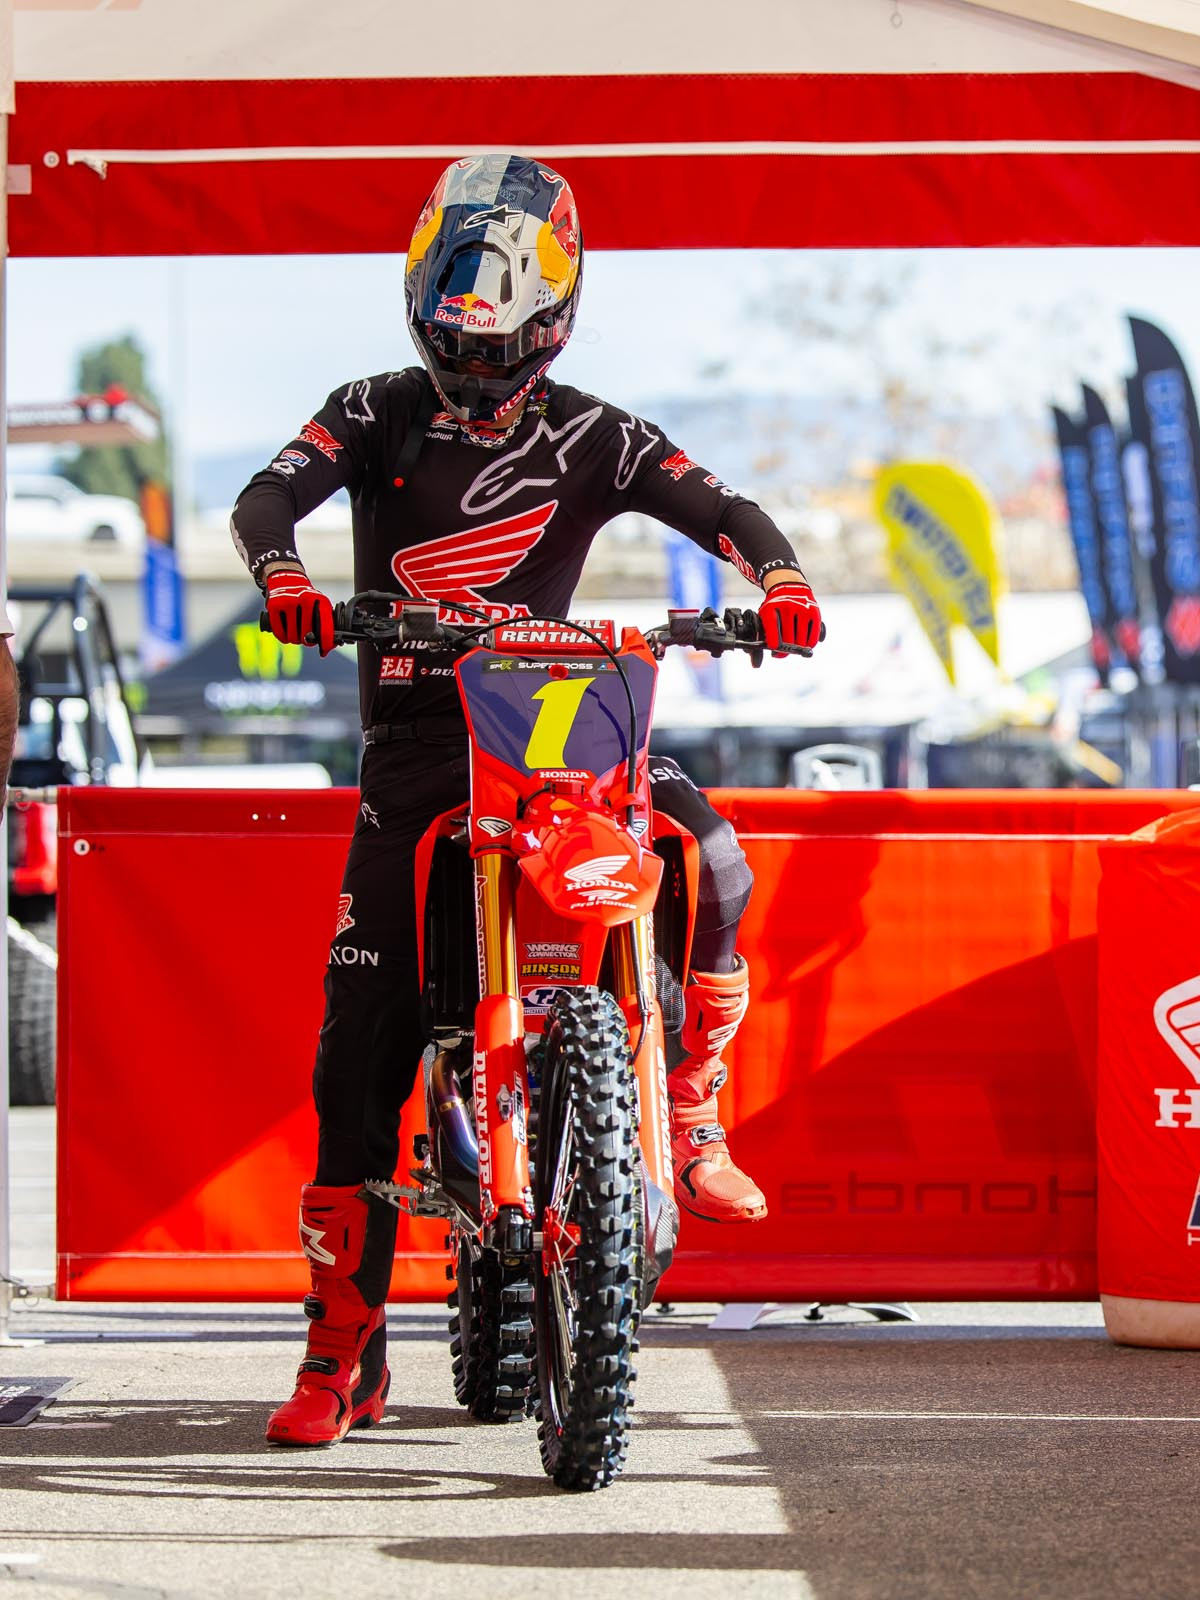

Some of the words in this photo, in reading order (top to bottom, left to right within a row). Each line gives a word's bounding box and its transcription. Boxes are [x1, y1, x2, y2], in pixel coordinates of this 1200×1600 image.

[434, 309, 467, 325] Red
[466, 314, 496, 328] Bull
[501, 630, 609, 644] RENTHAL
[518, 662, 594, 670] SUPEROSS
[524, 677, 597, 769] 1
[539, 771, 590, 779] HONDA
[565, 880, 639, 892] HONDA
[526, 943, 579, 952] WORKS
[521, 963, 581, 974] HINSON
[474, 1050, 491, 1184] DUNLOP
